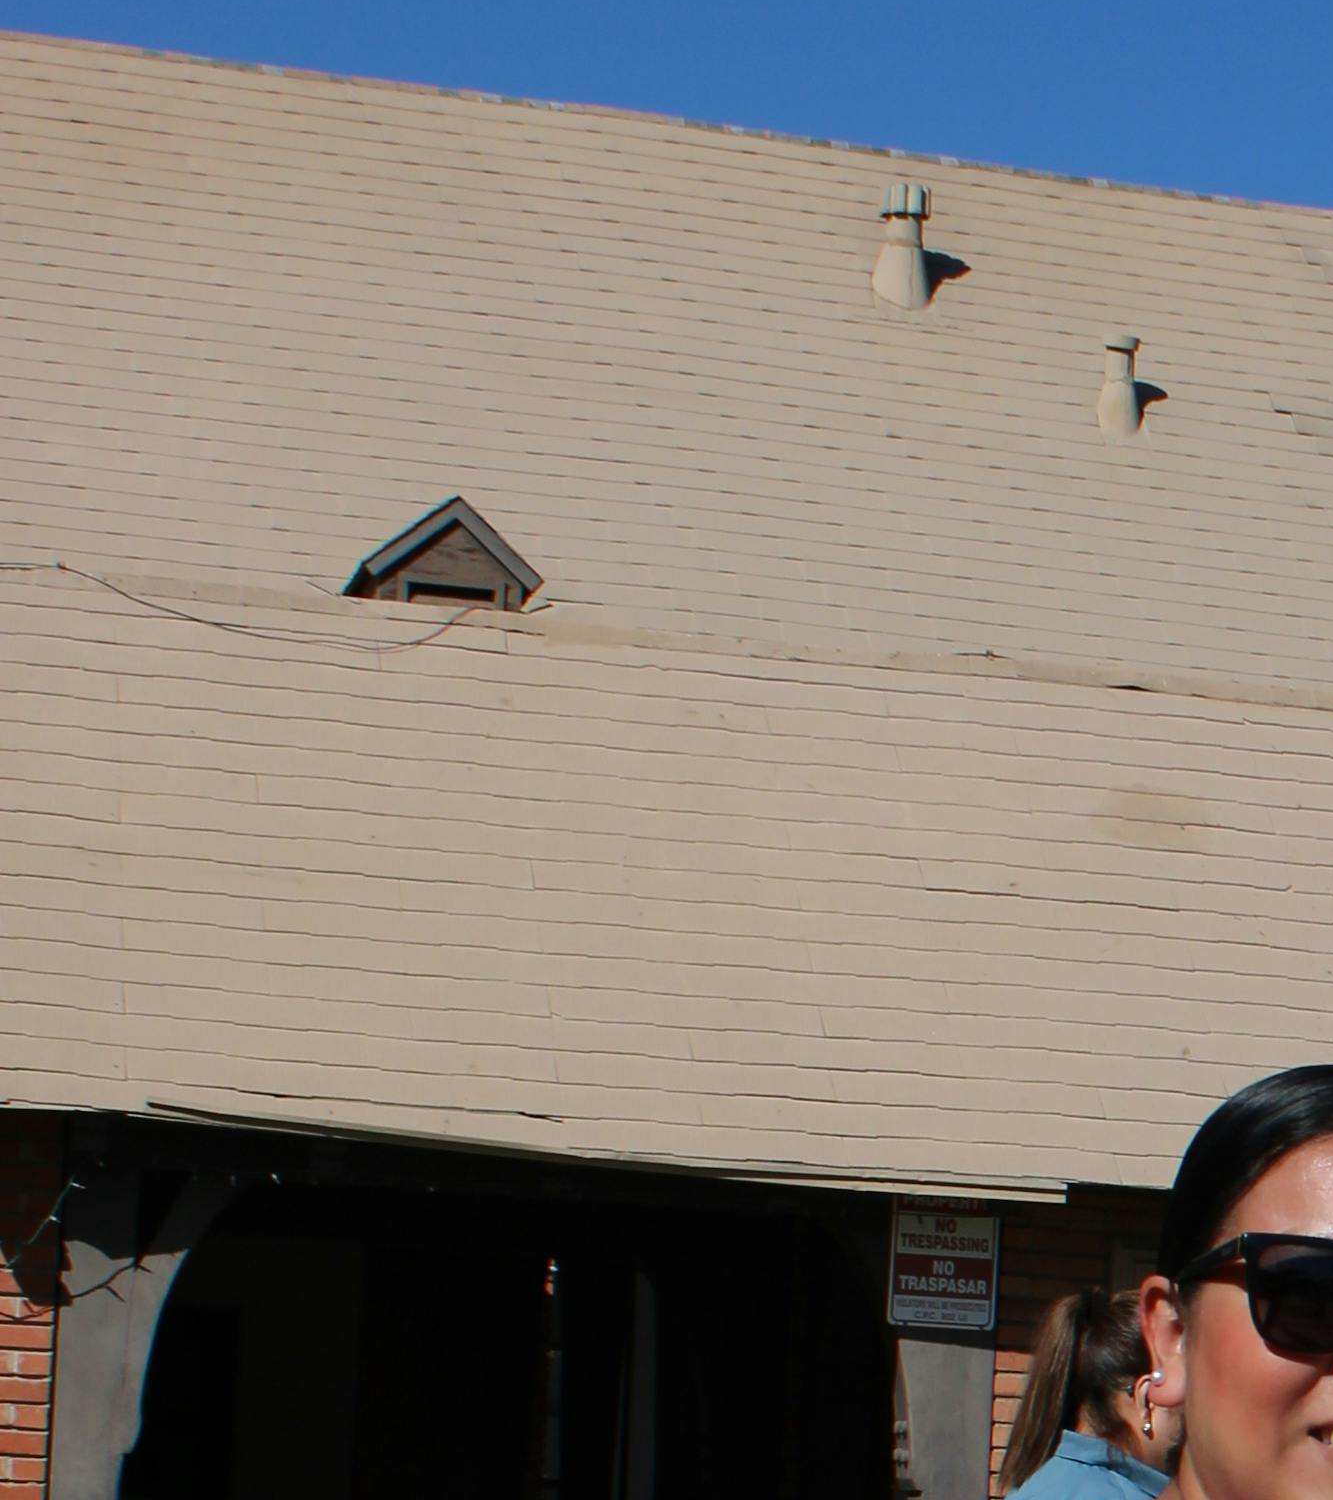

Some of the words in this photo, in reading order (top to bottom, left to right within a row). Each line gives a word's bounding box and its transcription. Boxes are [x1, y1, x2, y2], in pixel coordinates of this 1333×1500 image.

[935, 1218, 957, 1233] NO
[901, 1233, 989, 1253] TRESPASSING
[932, 1260, 955, 1276] NO
[898, 1275, 987, 1295] TRASPASAR
